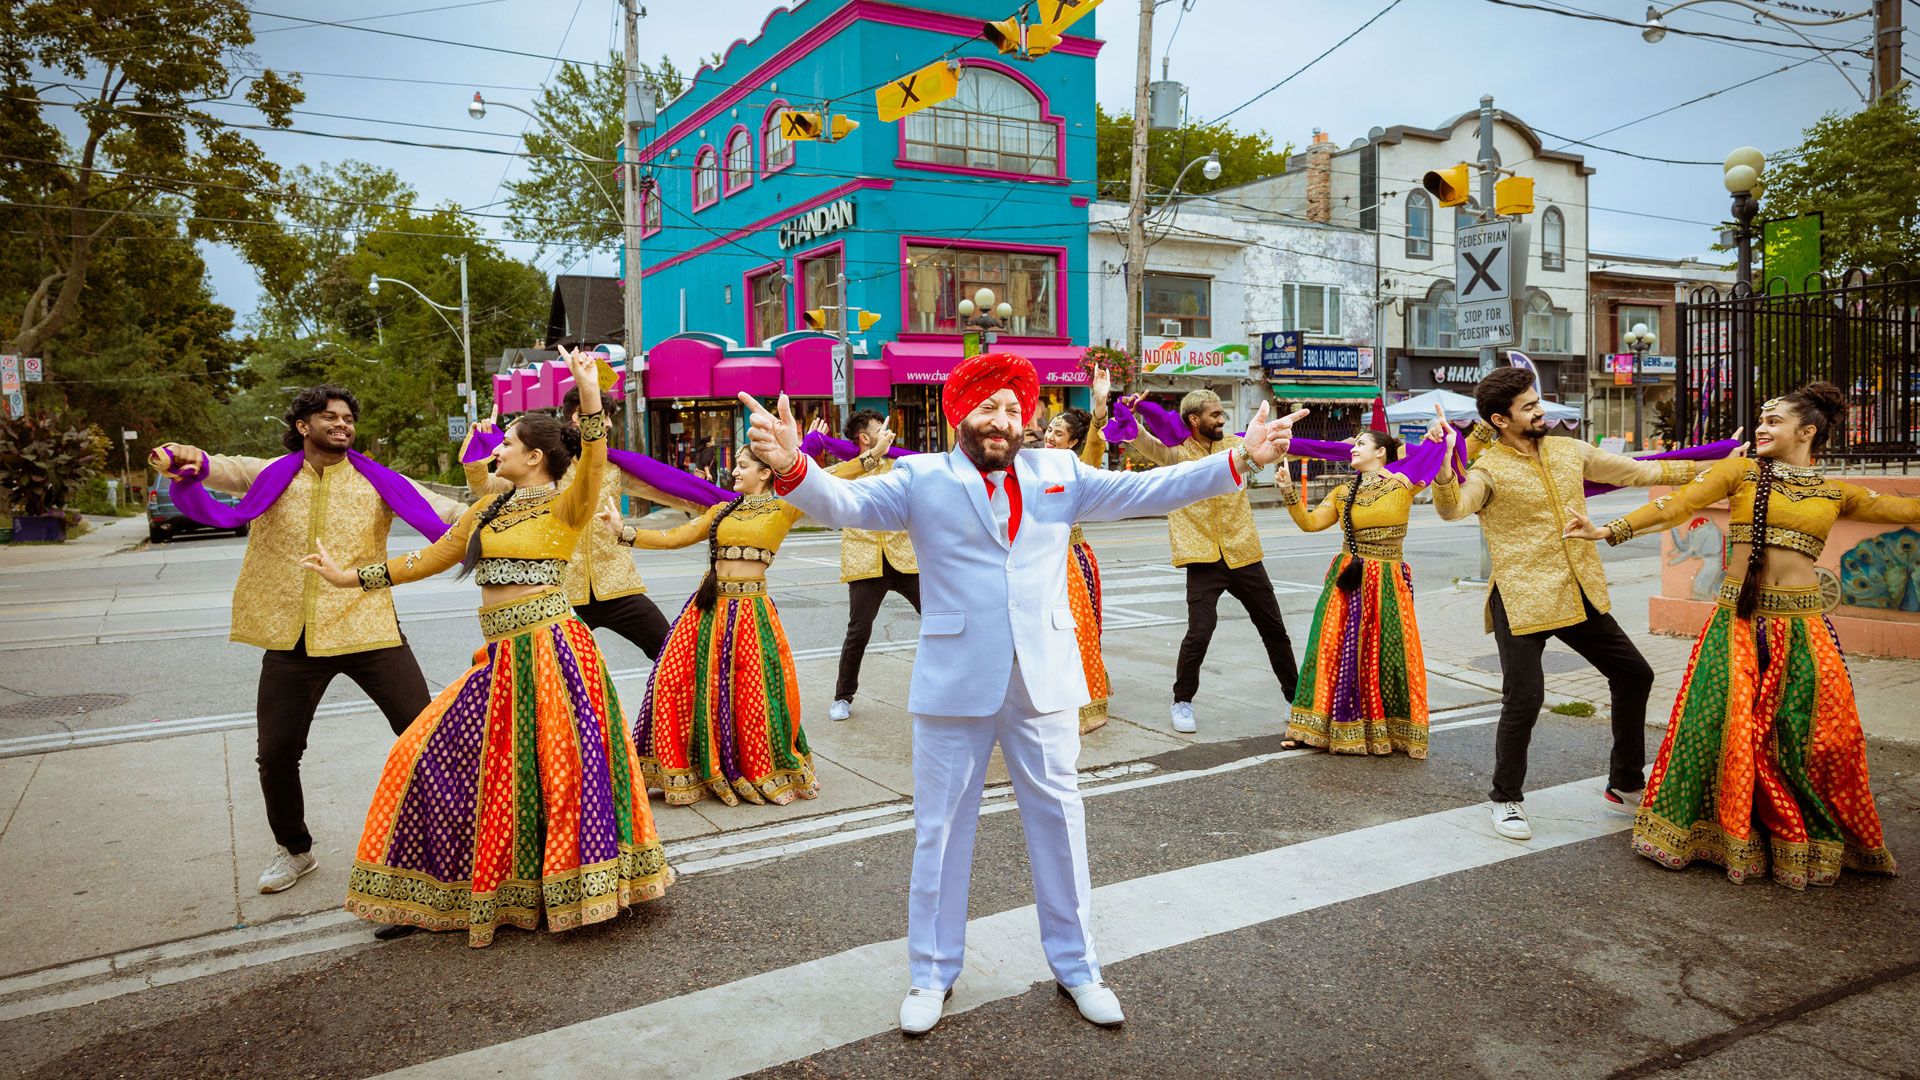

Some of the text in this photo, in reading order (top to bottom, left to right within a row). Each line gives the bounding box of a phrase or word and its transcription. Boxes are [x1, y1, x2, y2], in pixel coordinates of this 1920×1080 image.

[778, 200, 853, 250] CHANDAN
[1458, 230, 1507, 248] PEDESTRIAN
[1464, 307, 1502, 323] STOP FOR
[1144, 349, 1225, 367] NDIAN RASOI
[1307, 349, 1319, 368] BBQ
[1337, 350, 1358, 369] CENTER
[1046, 371, 1090, 382] 416-462-027
[451, 425, 465, 434] 30
